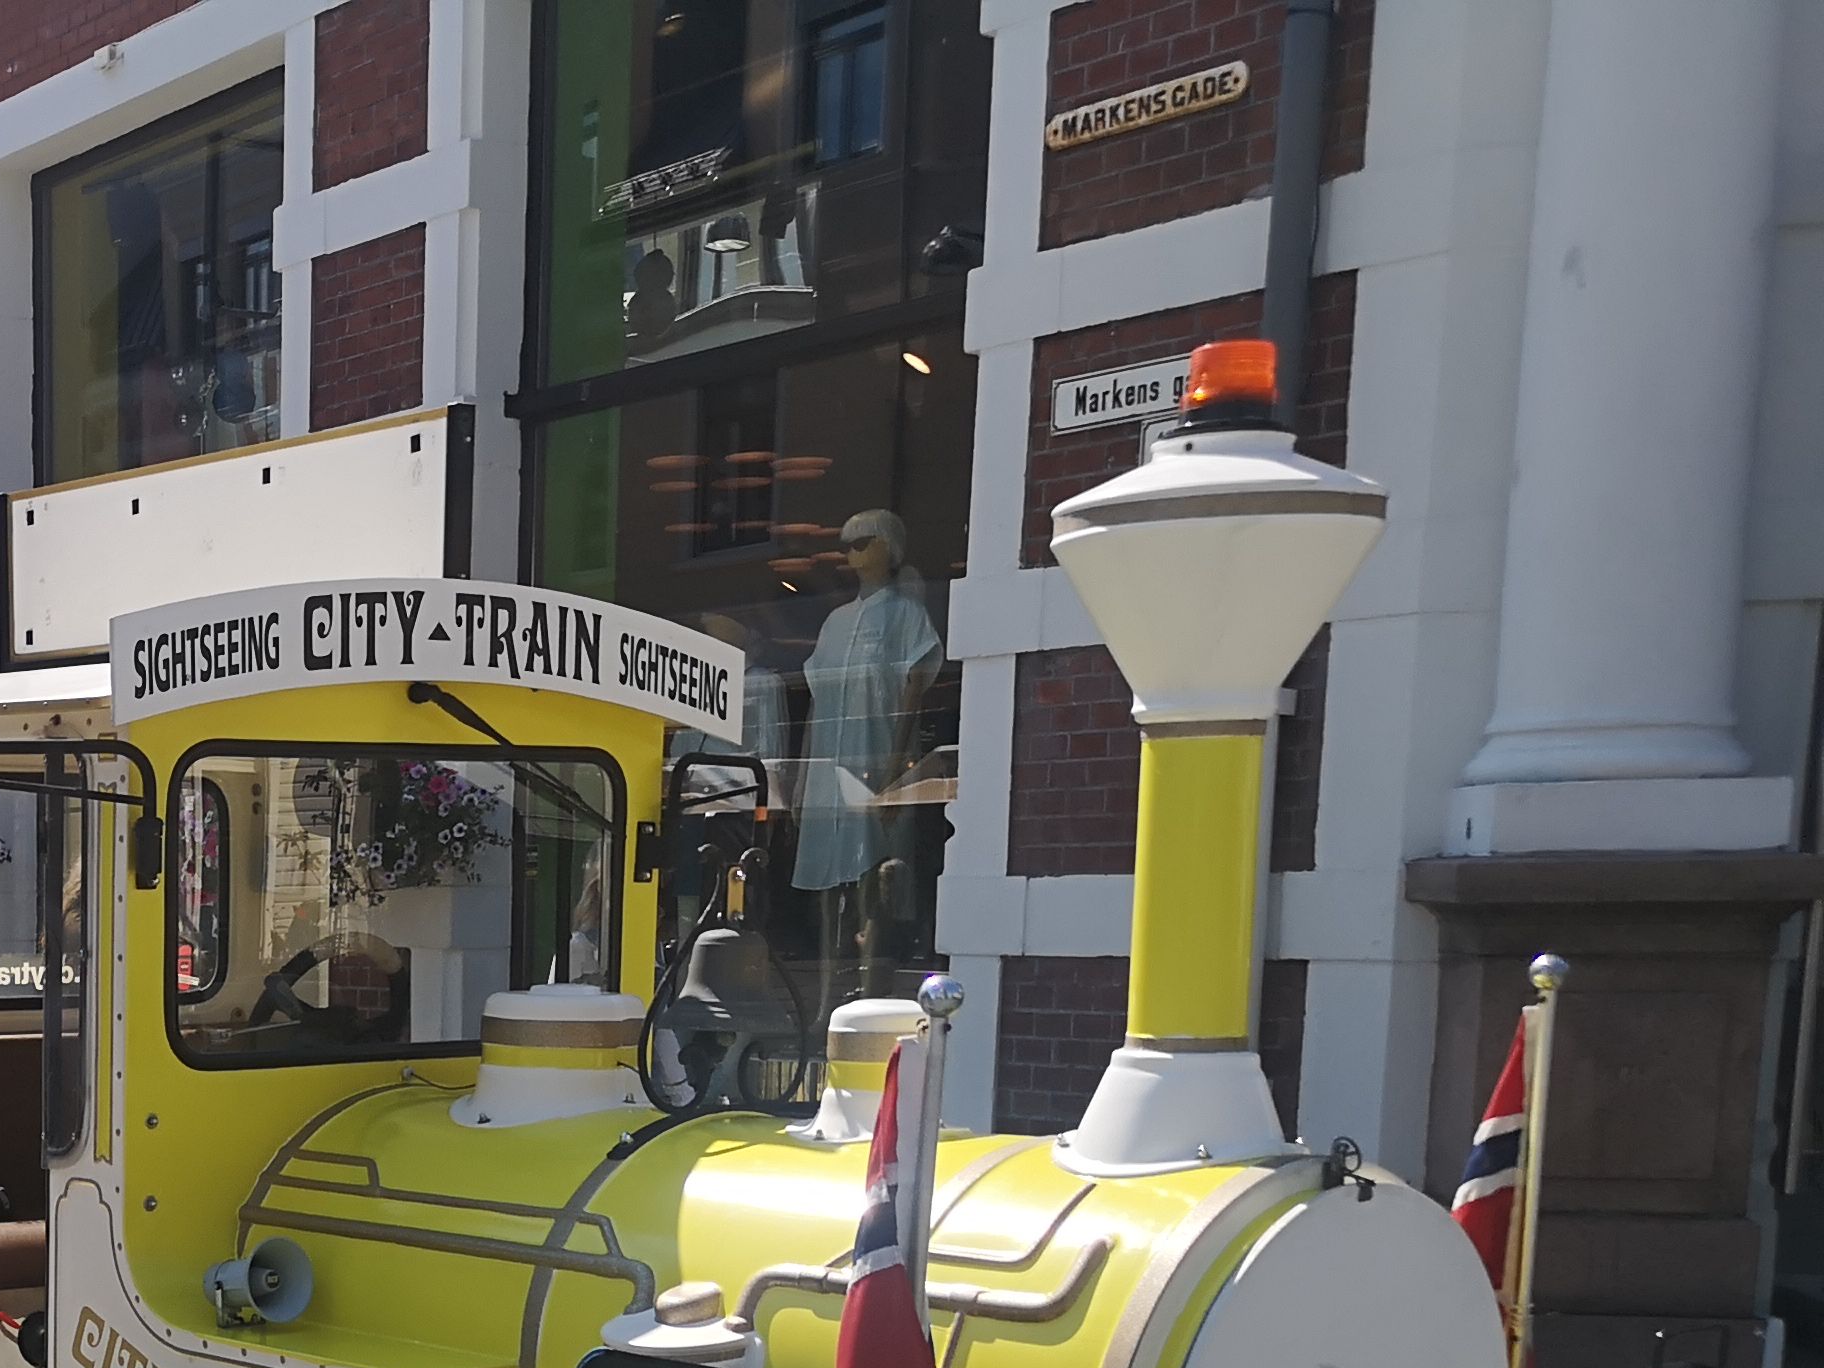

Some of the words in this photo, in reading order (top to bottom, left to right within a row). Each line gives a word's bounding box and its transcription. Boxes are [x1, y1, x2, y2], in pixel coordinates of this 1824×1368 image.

[1074, 377, 1160, 417] Markens
[133, 611, 280, 700] SIGHTSEEING
[303, 590, 426, 671] CITY
[455, 592, 603, 686] TRAIN
[618, 632, 729, 721] SIGHTSEEING
